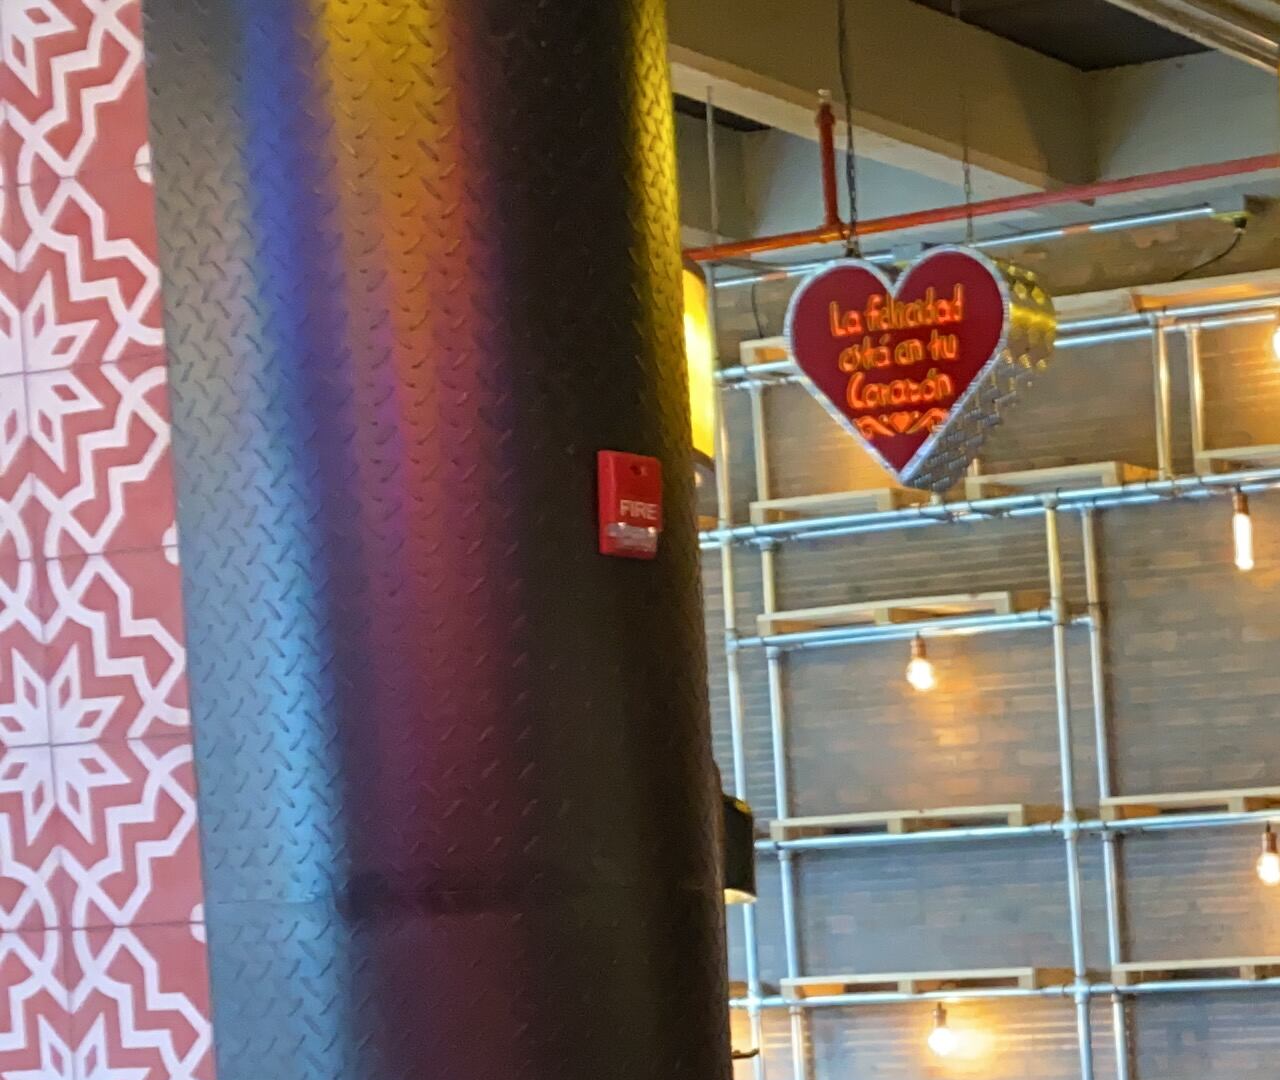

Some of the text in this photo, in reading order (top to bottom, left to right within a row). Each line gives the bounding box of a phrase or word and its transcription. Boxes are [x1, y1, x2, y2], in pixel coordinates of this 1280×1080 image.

[828, 283, 964, 336] La felicidad
[895, 339, 923, 365] en
[927, 329, 958, 361] tu
[620, 499, 658, 520] FIRE
